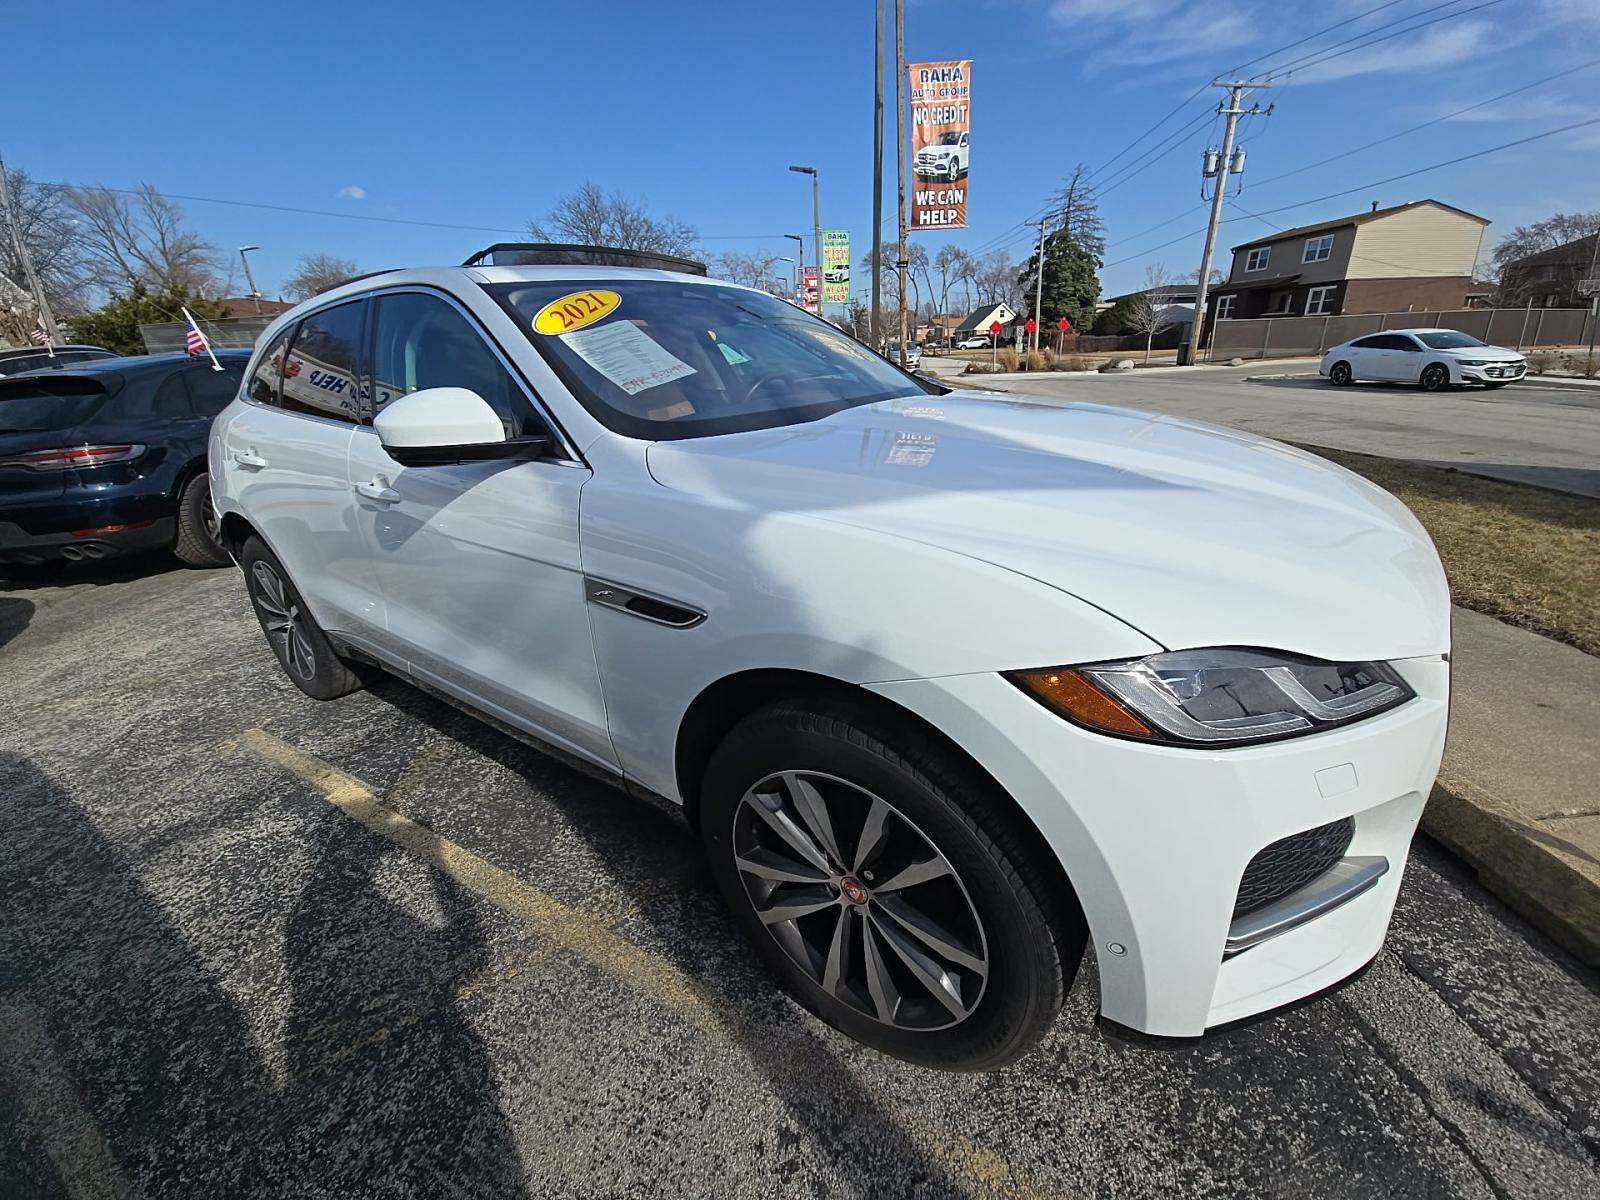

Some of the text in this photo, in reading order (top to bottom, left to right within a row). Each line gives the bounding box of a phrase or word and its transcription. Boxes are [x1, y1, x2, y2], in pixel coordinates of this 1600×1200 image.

[920, 67, 963, 83] BAHA
[912, 86, 968, 98] AUTO GROUP
[913, 105, 967, 126] NO CREDIT
[916, 189, 964, 206] WE CAN
[919, 209, 958, 225] HELP
[827, 294, 846, 302] HELP
[549, 293, 608, 329] 2021
